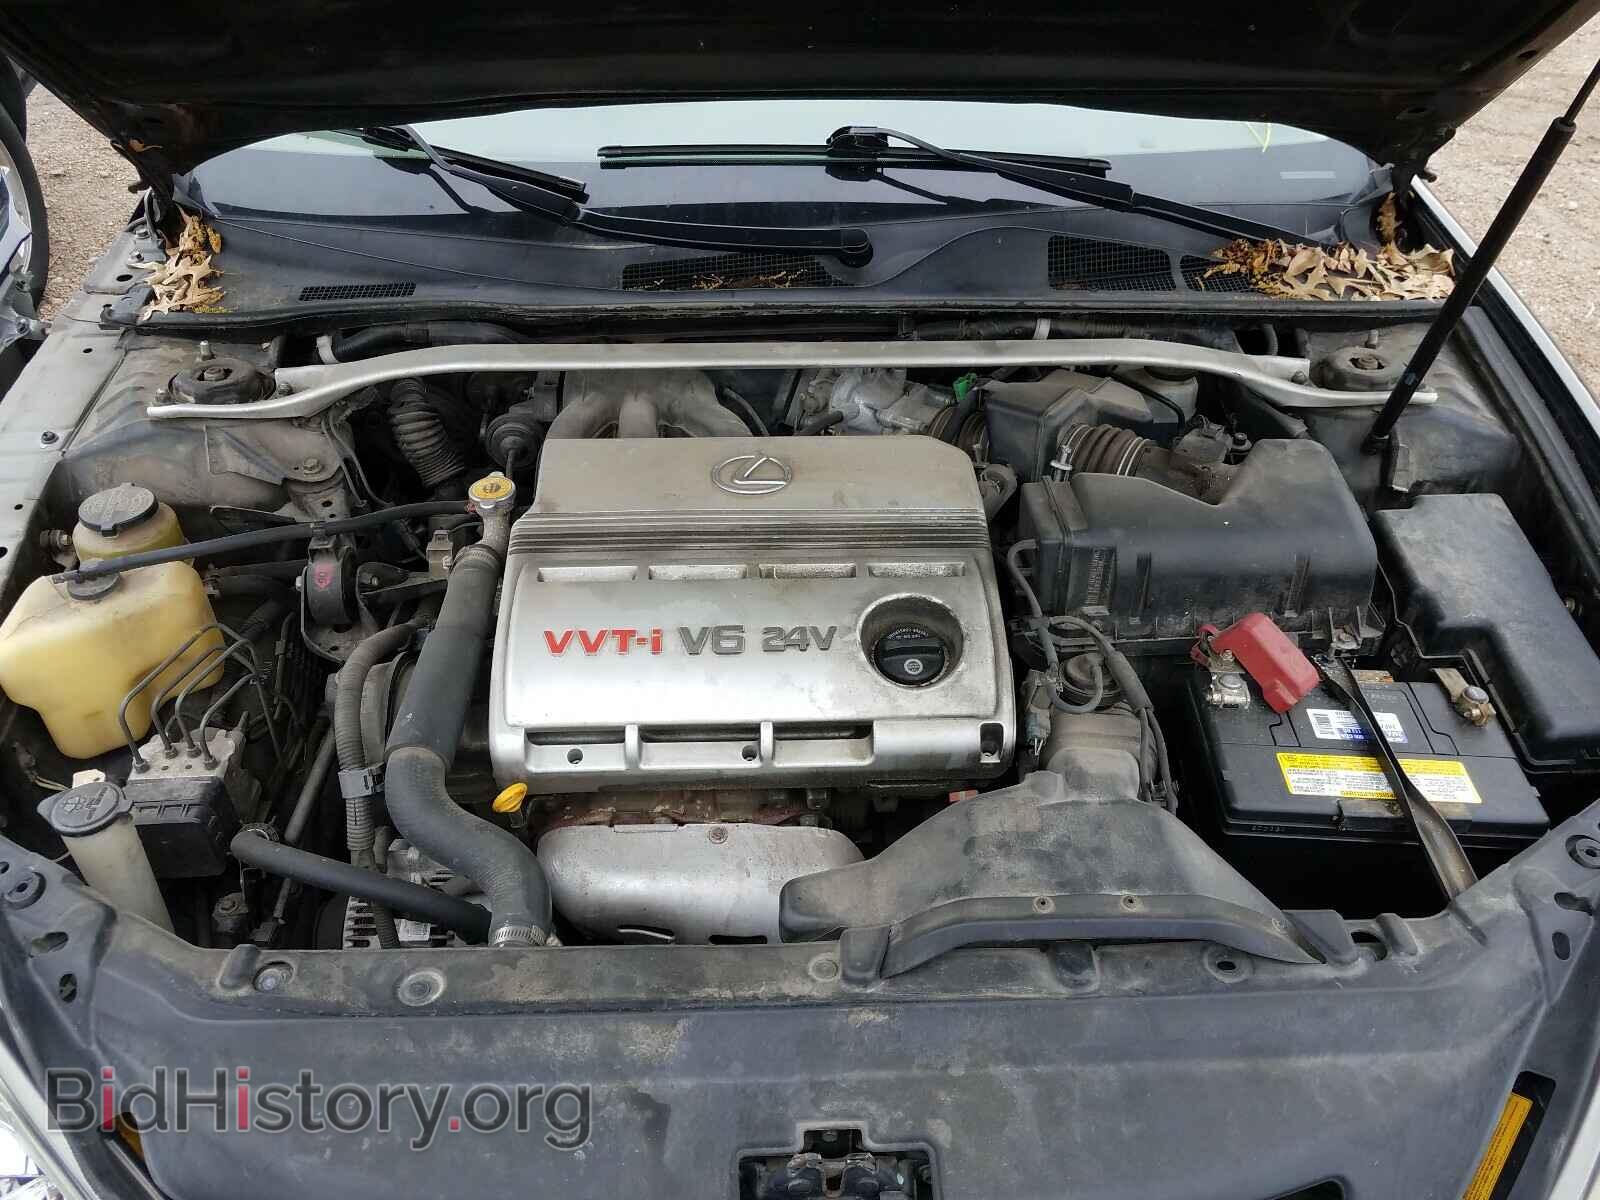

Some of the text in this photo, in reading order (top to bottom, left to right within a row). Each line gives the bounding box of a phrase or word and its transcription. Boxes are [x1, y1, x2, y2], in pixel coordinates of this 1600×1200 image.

[543, 625, 838, 655] VVT-i V6 24V
